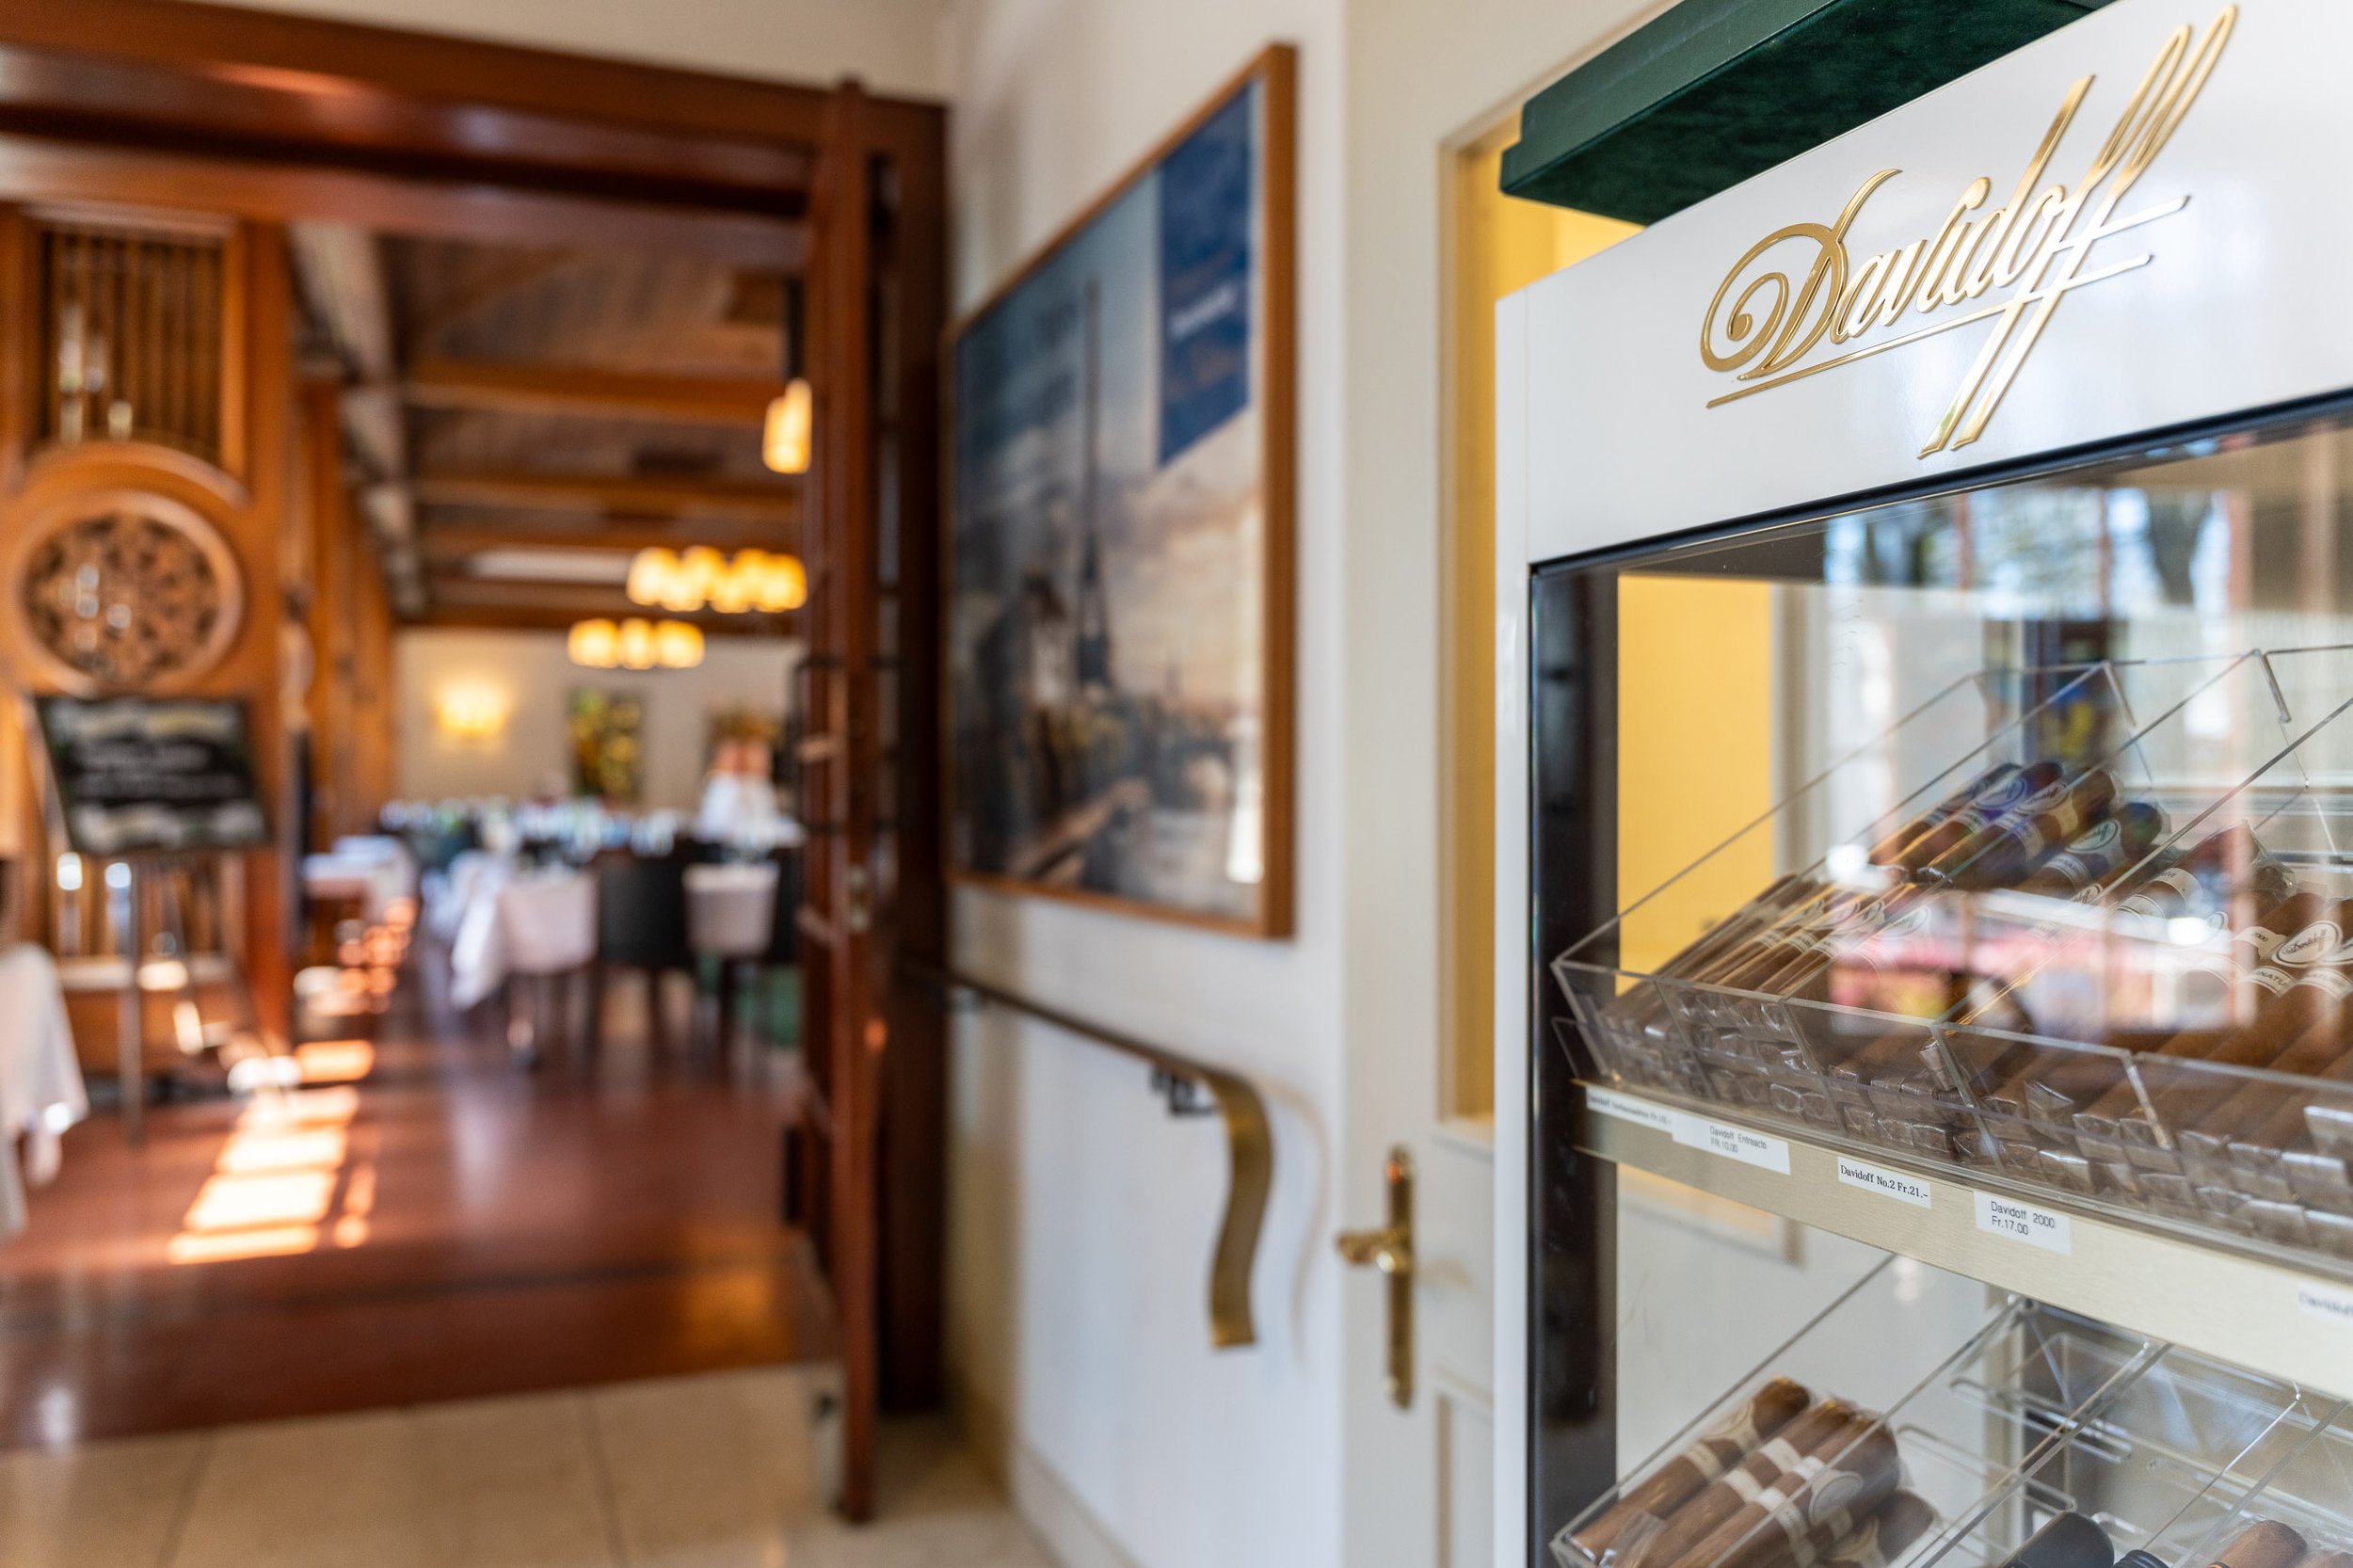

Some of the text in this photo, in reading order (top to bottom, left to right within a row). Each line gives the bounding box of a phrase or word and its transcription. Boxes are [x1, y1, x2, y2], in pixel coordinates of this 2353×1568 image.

[1700, 4, 2238, 459] Davidoff
[1709, 1125, 1767, 1150] Davidoff Entreacto
[1840, 1164, 1929, 1198] Davidoff No.2 Fr.21.-
[1991, 1200, 2056, 1229] Davidoff 2000
[1992, 1215, 2029, 1236] Fr.17.00
